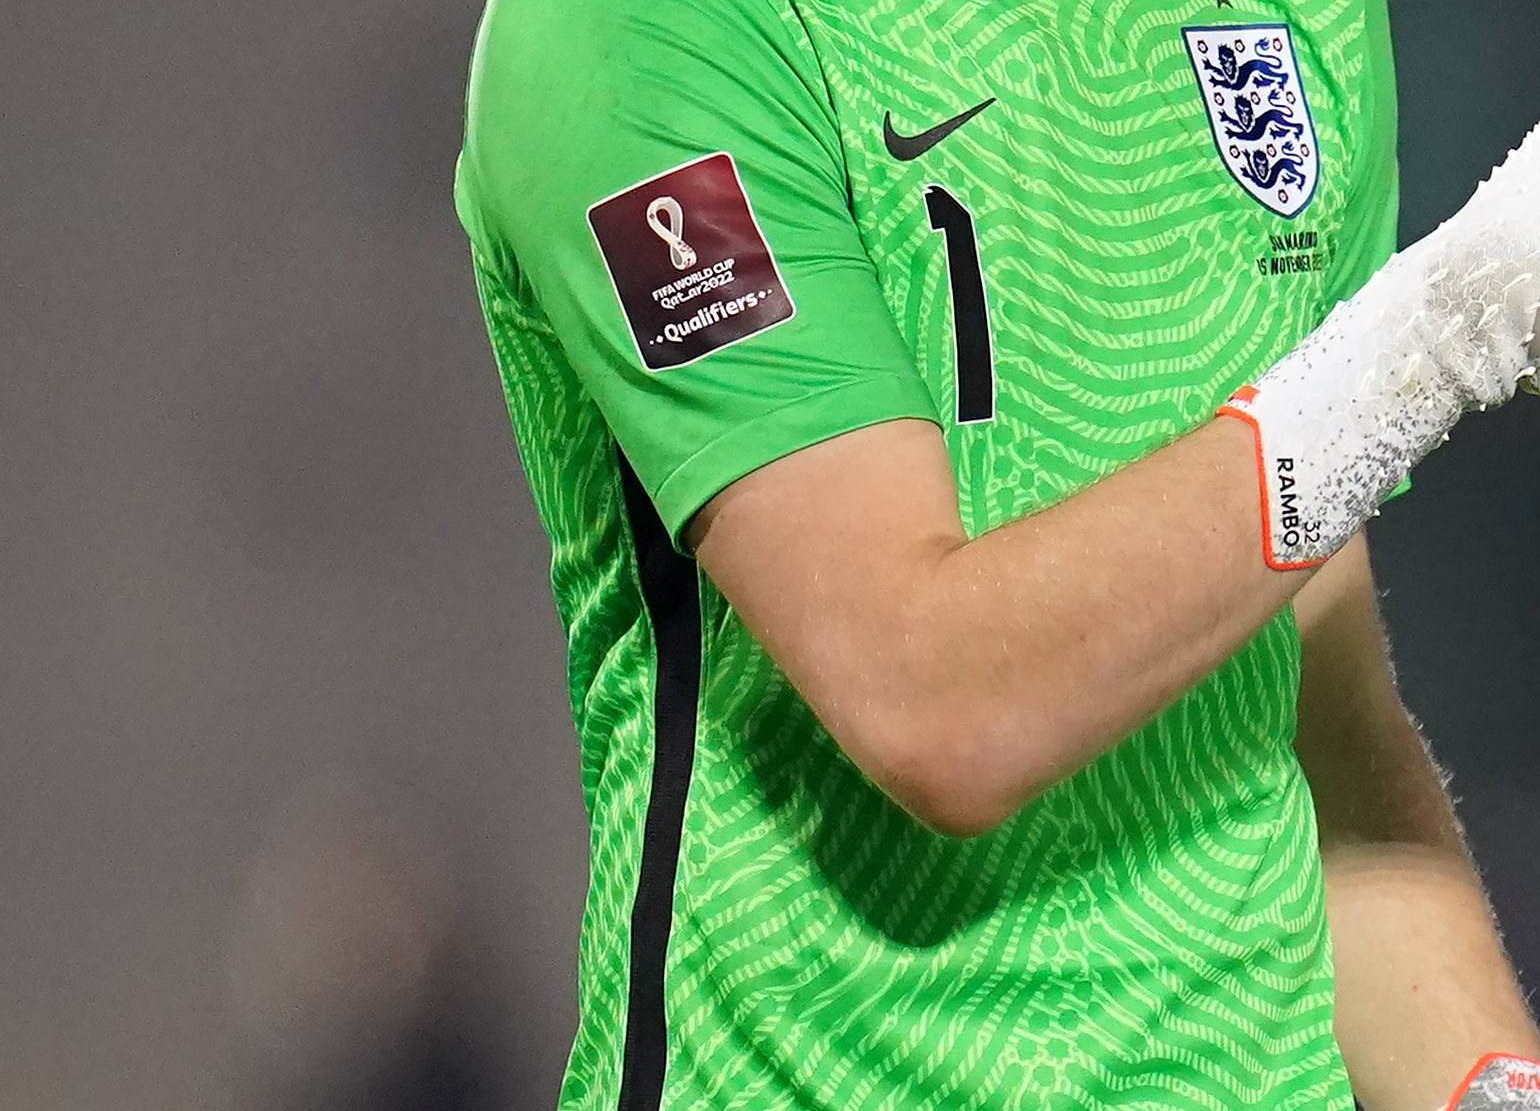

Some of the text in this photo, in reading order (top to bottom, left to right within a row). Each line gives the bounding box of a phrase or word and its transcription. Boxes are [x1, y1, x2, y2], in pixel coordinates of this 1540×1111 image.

[652, 258, 735, 301] FIFA WORLD CUP
[924, 185, 994, 425] 1
[1277, 457, 1300, 548] RAMBO
[1304, 520, 1321, 544] 32
